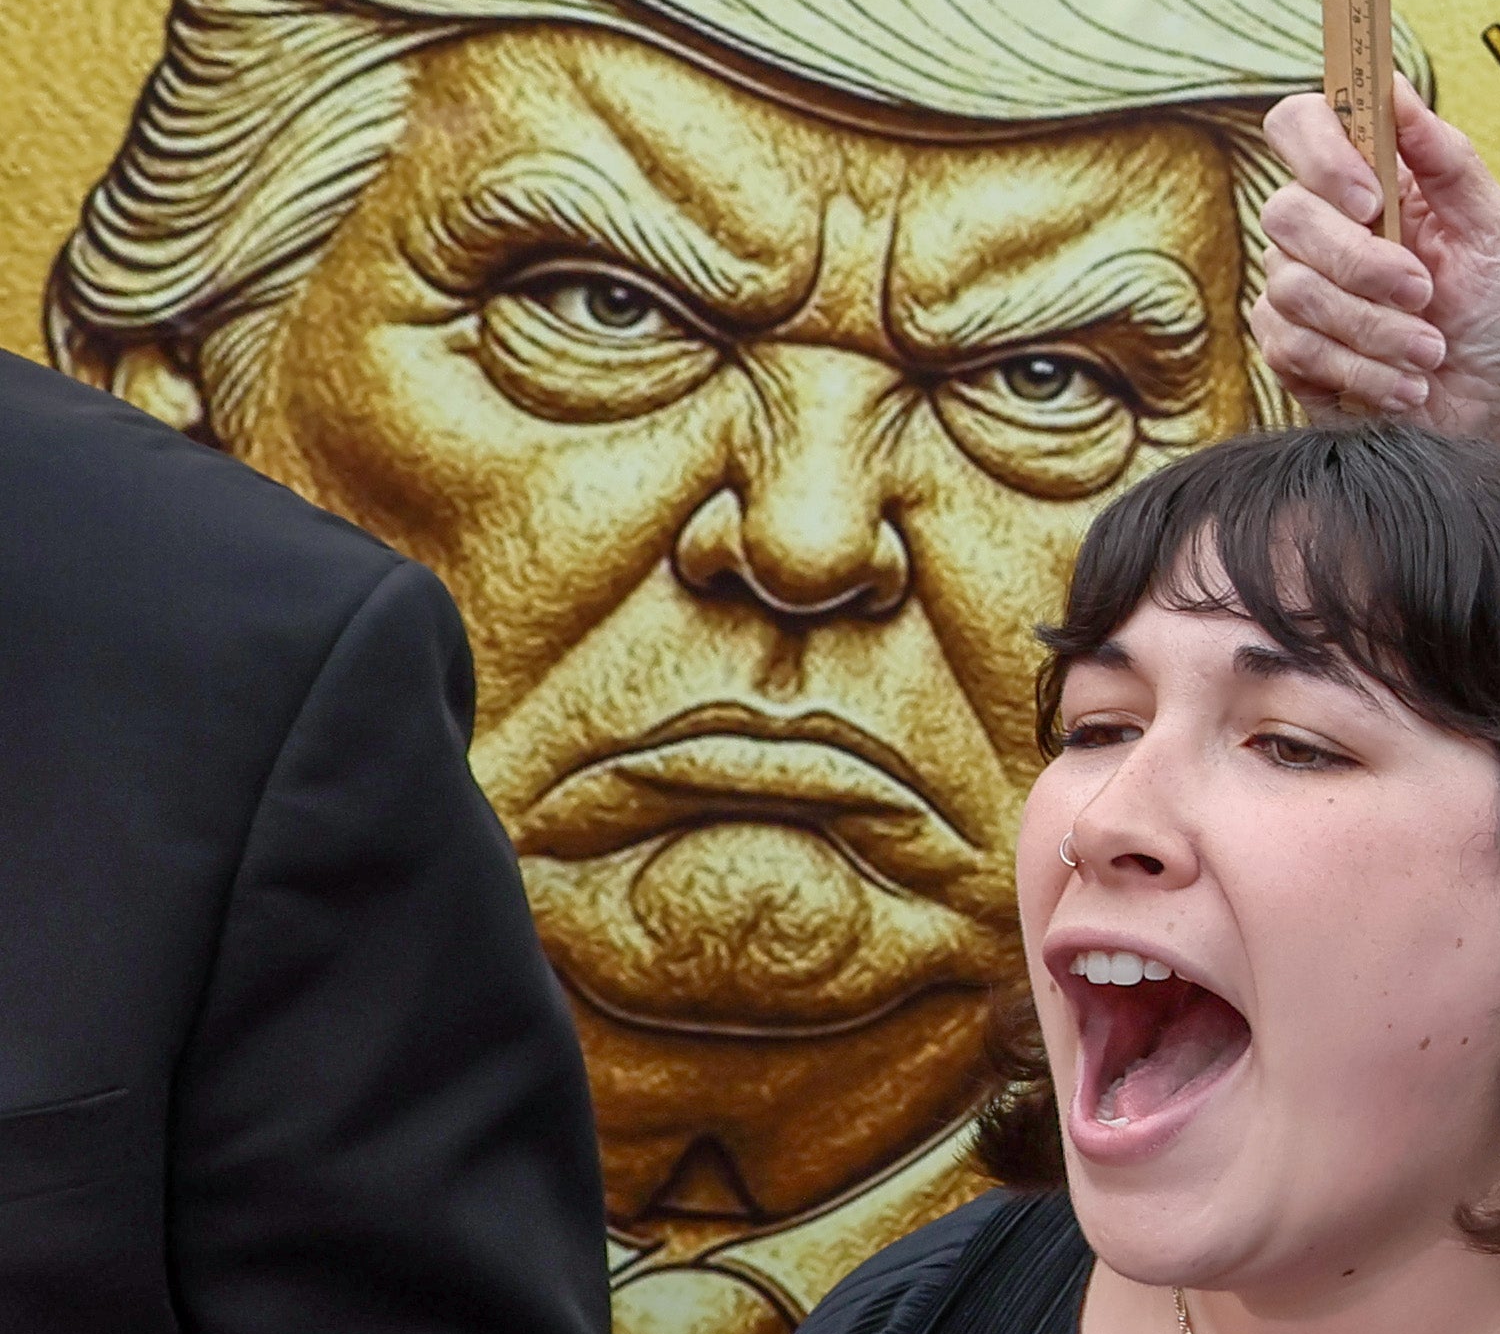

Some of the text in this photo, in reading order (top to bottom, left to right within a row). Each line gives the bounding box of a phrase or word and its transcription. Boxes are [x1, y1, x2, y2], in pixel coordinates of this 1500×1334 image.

[1351, 6, 1362, 24] 78
[1352, 38, 1363, 56] 79
[1354, 67, 1364, 88] 80
[1355, 98, 1364, 112] 81
[1357, 126, 1366, 143] 82
